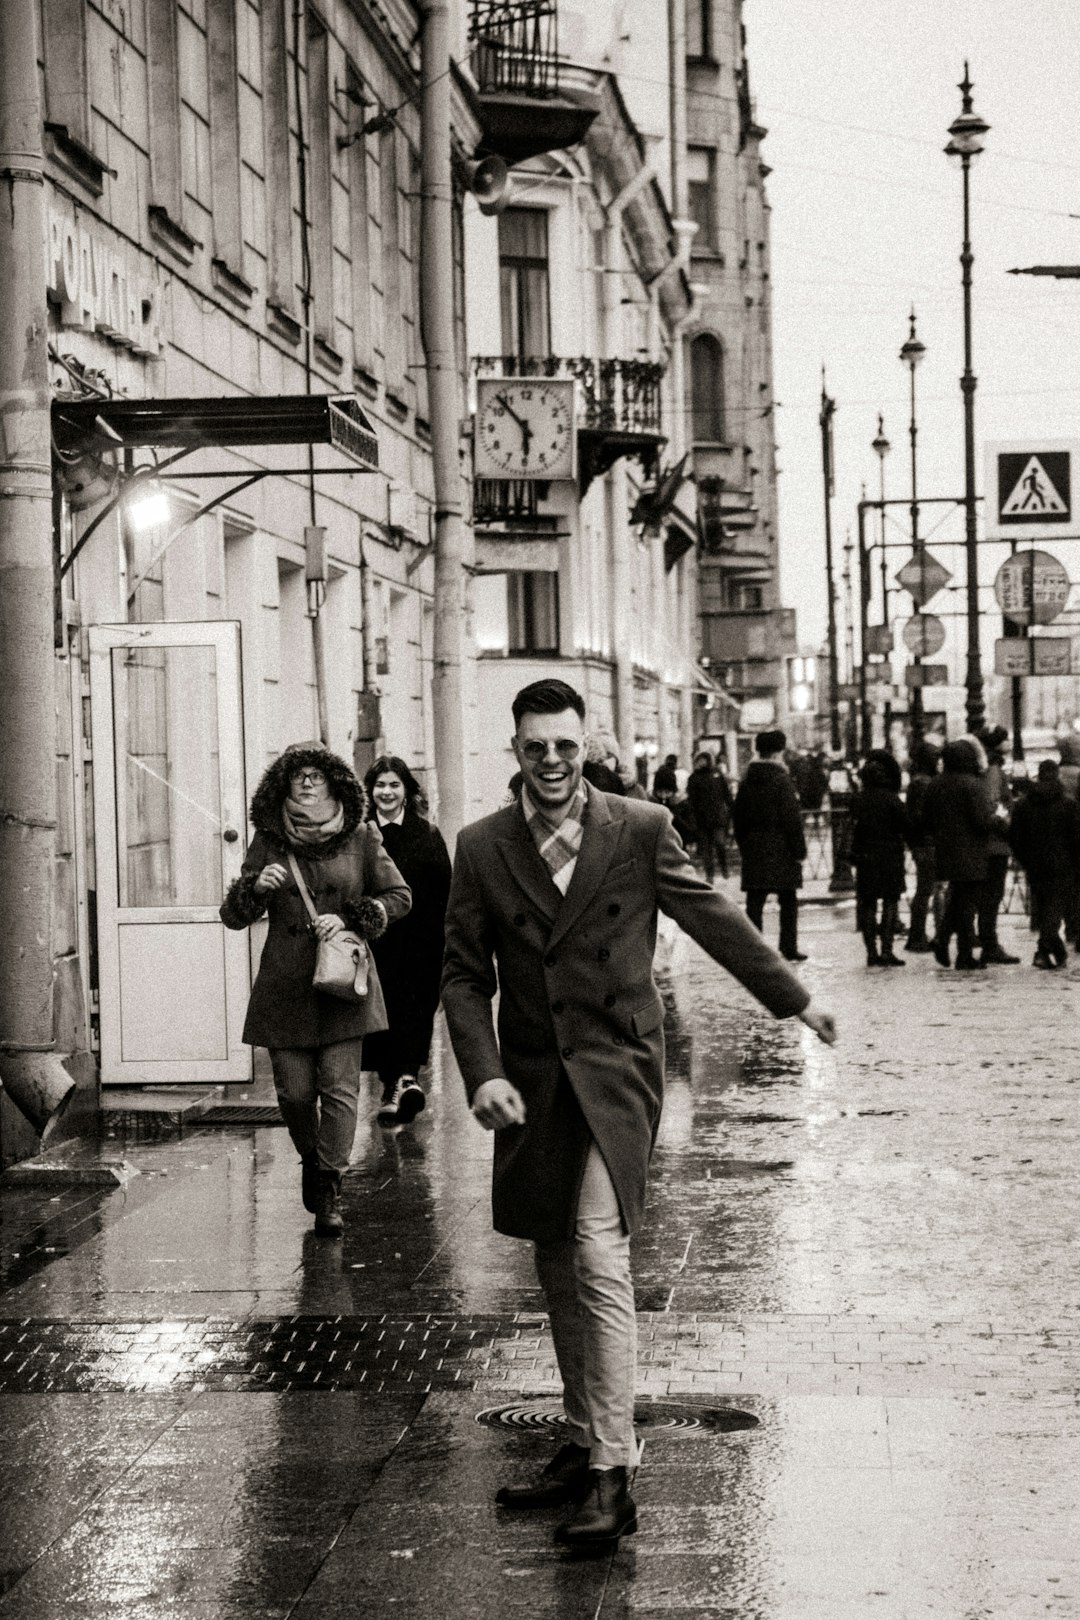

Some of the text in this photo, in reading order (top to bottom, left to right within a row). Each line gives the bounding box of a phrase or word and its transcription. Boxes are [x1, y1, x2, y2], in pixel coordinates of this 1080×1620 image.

[44, 205, 160, 354] РОДУКТЫ
[520, 390, 533, 401] 12
[540, 396, 546, 405] 1
[493, 407, 505, 417] 10
[552, 408, 559, 418] 2
[488, 423, 495, 433] 9
[557, 424, 563, 434] 3
[493, 440, 500, 450] 8
[551, 441, 557, 450] 4
[506, 452, 513, 462] 7
[539, 452, 546, 463] 5
